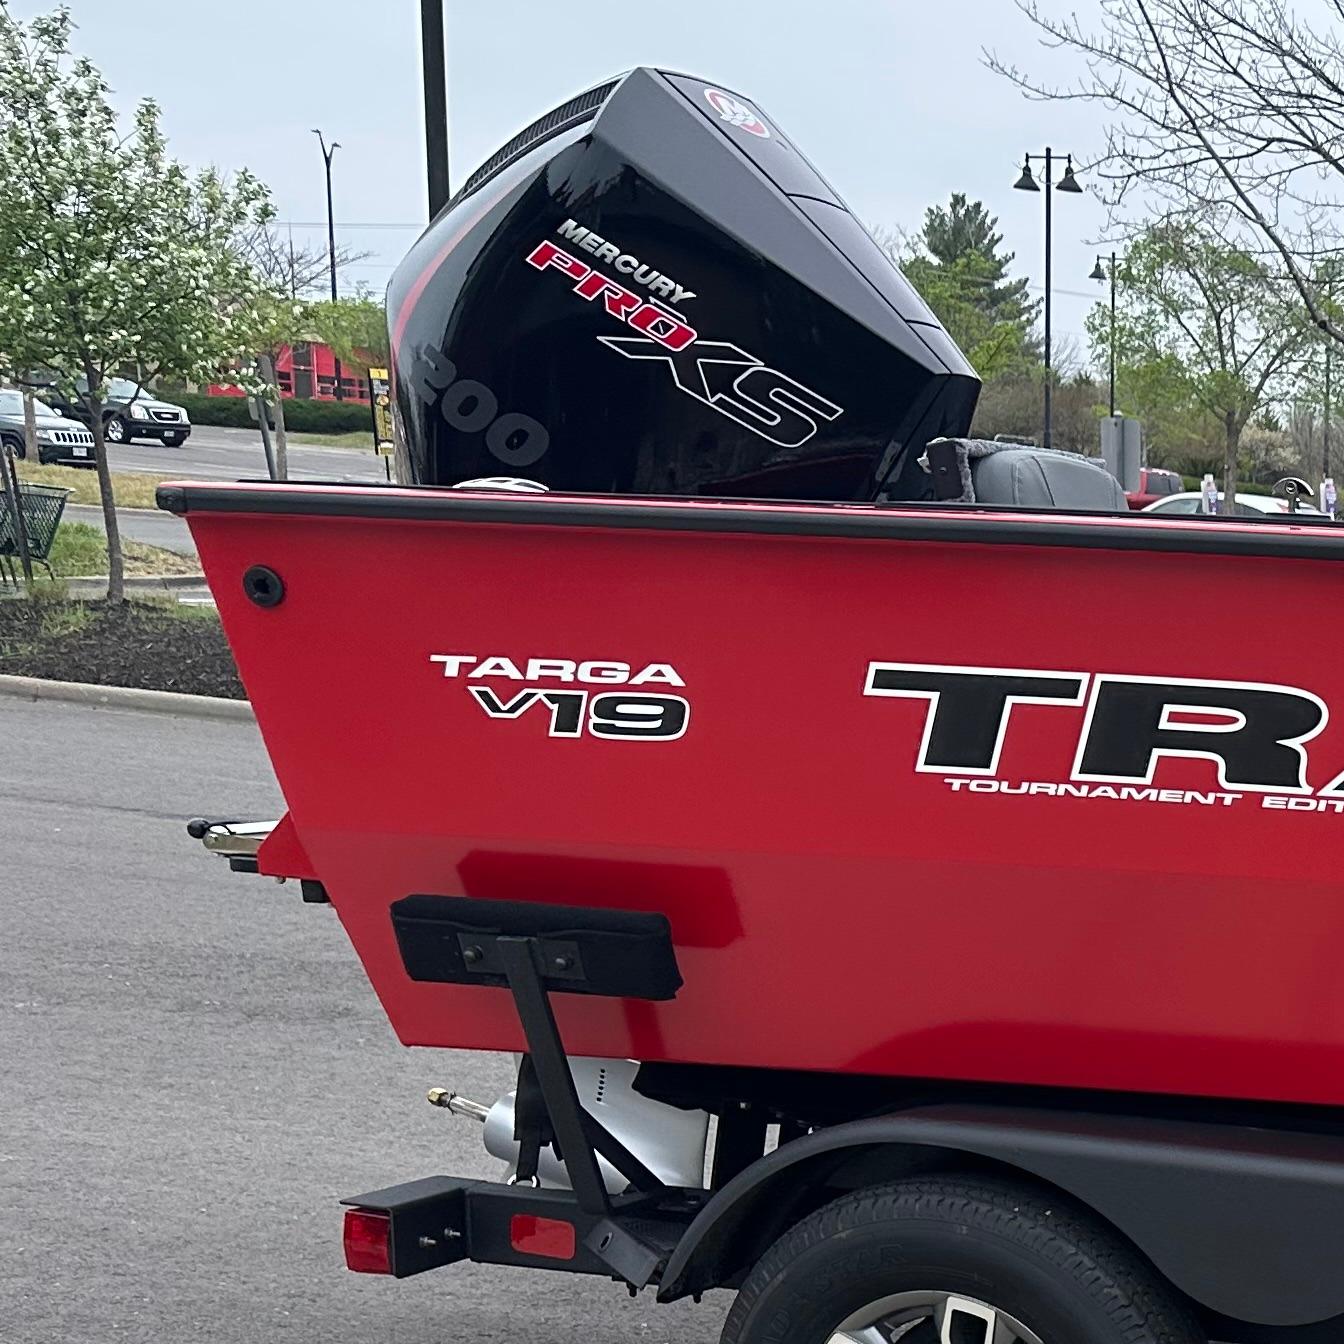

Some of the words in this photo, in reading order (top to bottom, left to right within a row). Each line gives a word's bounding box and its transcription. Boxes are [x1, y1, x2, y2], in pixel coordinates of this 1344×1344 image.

[525, 239, 698, 352] PRO
[556, 218, 697, 304] MERCURY
[410, 343, 550, 467] 200
[596, 335, 844, 448] XS
[429, 654, 687, 687] TARGA
[467, 685, 691, 742] V19
[943, 777, 1243, 807] TOURNAMENT
